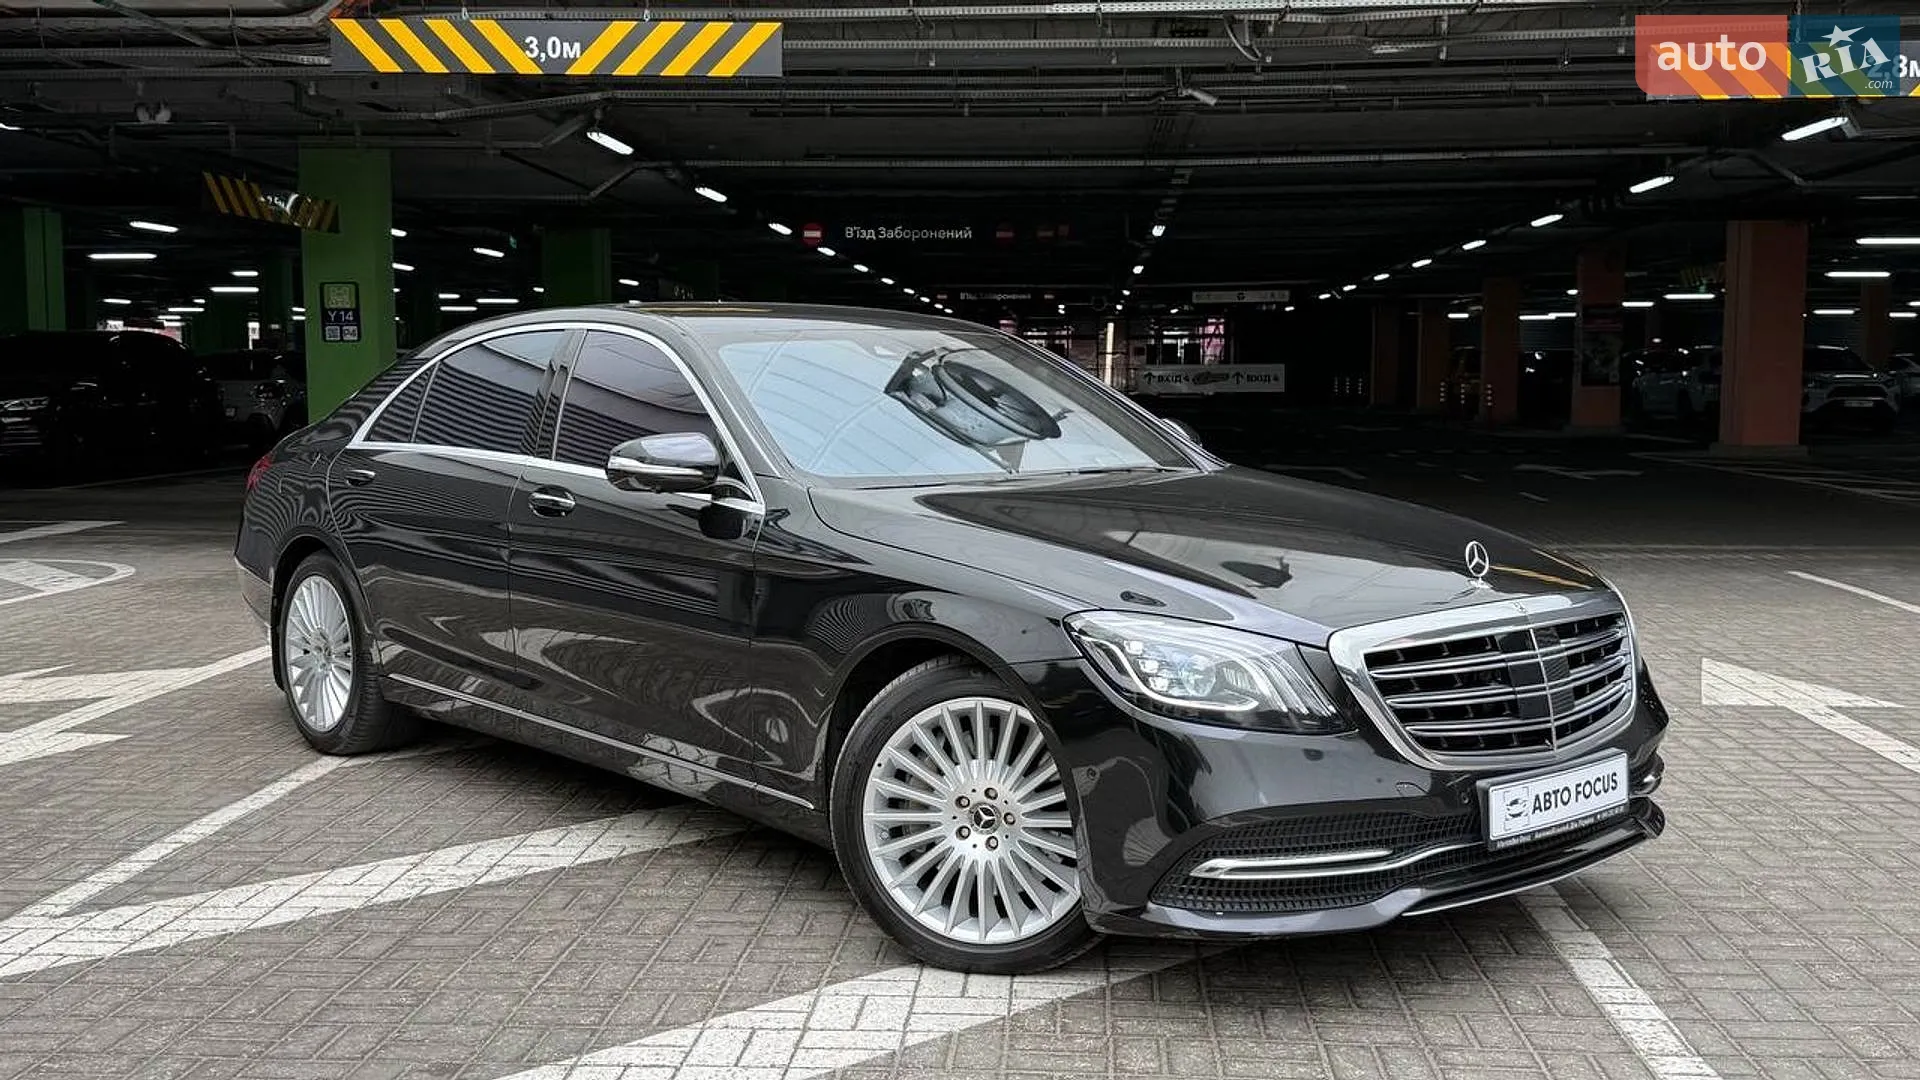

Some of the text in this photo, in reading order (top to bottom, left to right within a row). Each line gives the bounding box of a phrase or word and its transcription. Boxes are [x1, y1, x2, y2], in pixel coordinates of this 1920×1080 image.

[525, 36, 581, 62] 3,0м
[878, 226, 973, 241] Заборонений
[339, 310, 354, 322] 14
[1575, 772, 1618, 802] FOCUS
